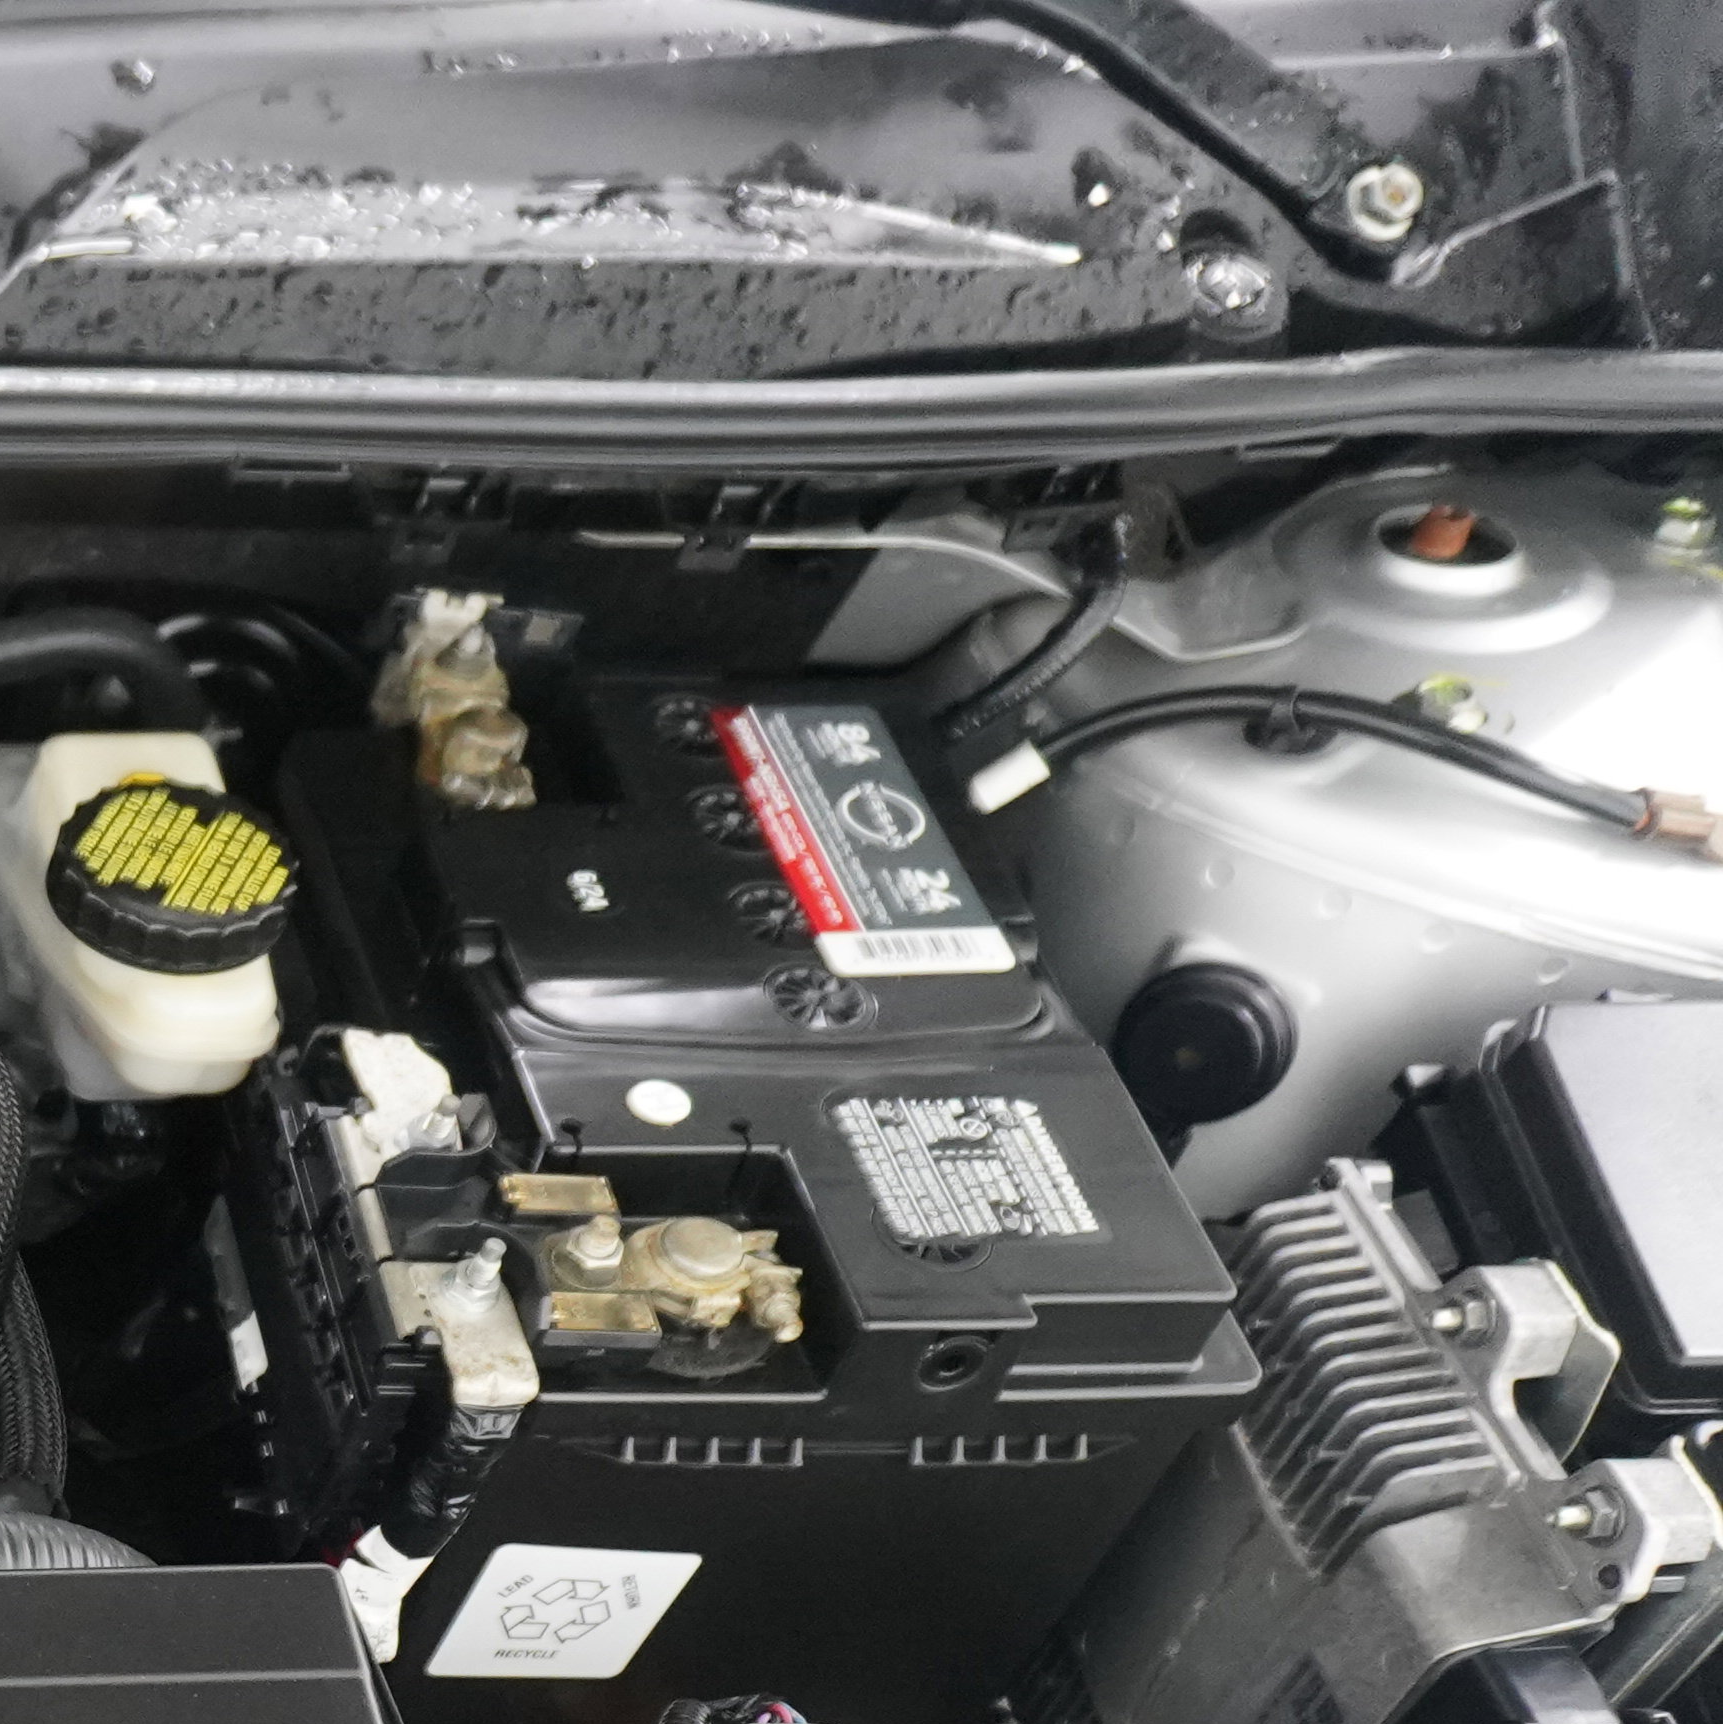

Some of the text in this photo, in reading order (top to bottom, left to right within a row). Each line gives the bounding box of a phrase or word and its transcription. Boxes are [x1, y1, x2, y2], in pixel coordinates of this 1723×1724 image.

[860, 781, 907, 848] NISSAN
[1020, 1114, 1069, 1172] DANGER
[1051, 1173, 1098, 1230] POISON
[498, 1573, 535, 1599] LEAD
[620, 1574, 643, 1611] RETURN
[493, 1647, 562, 1661] RECYCLE
